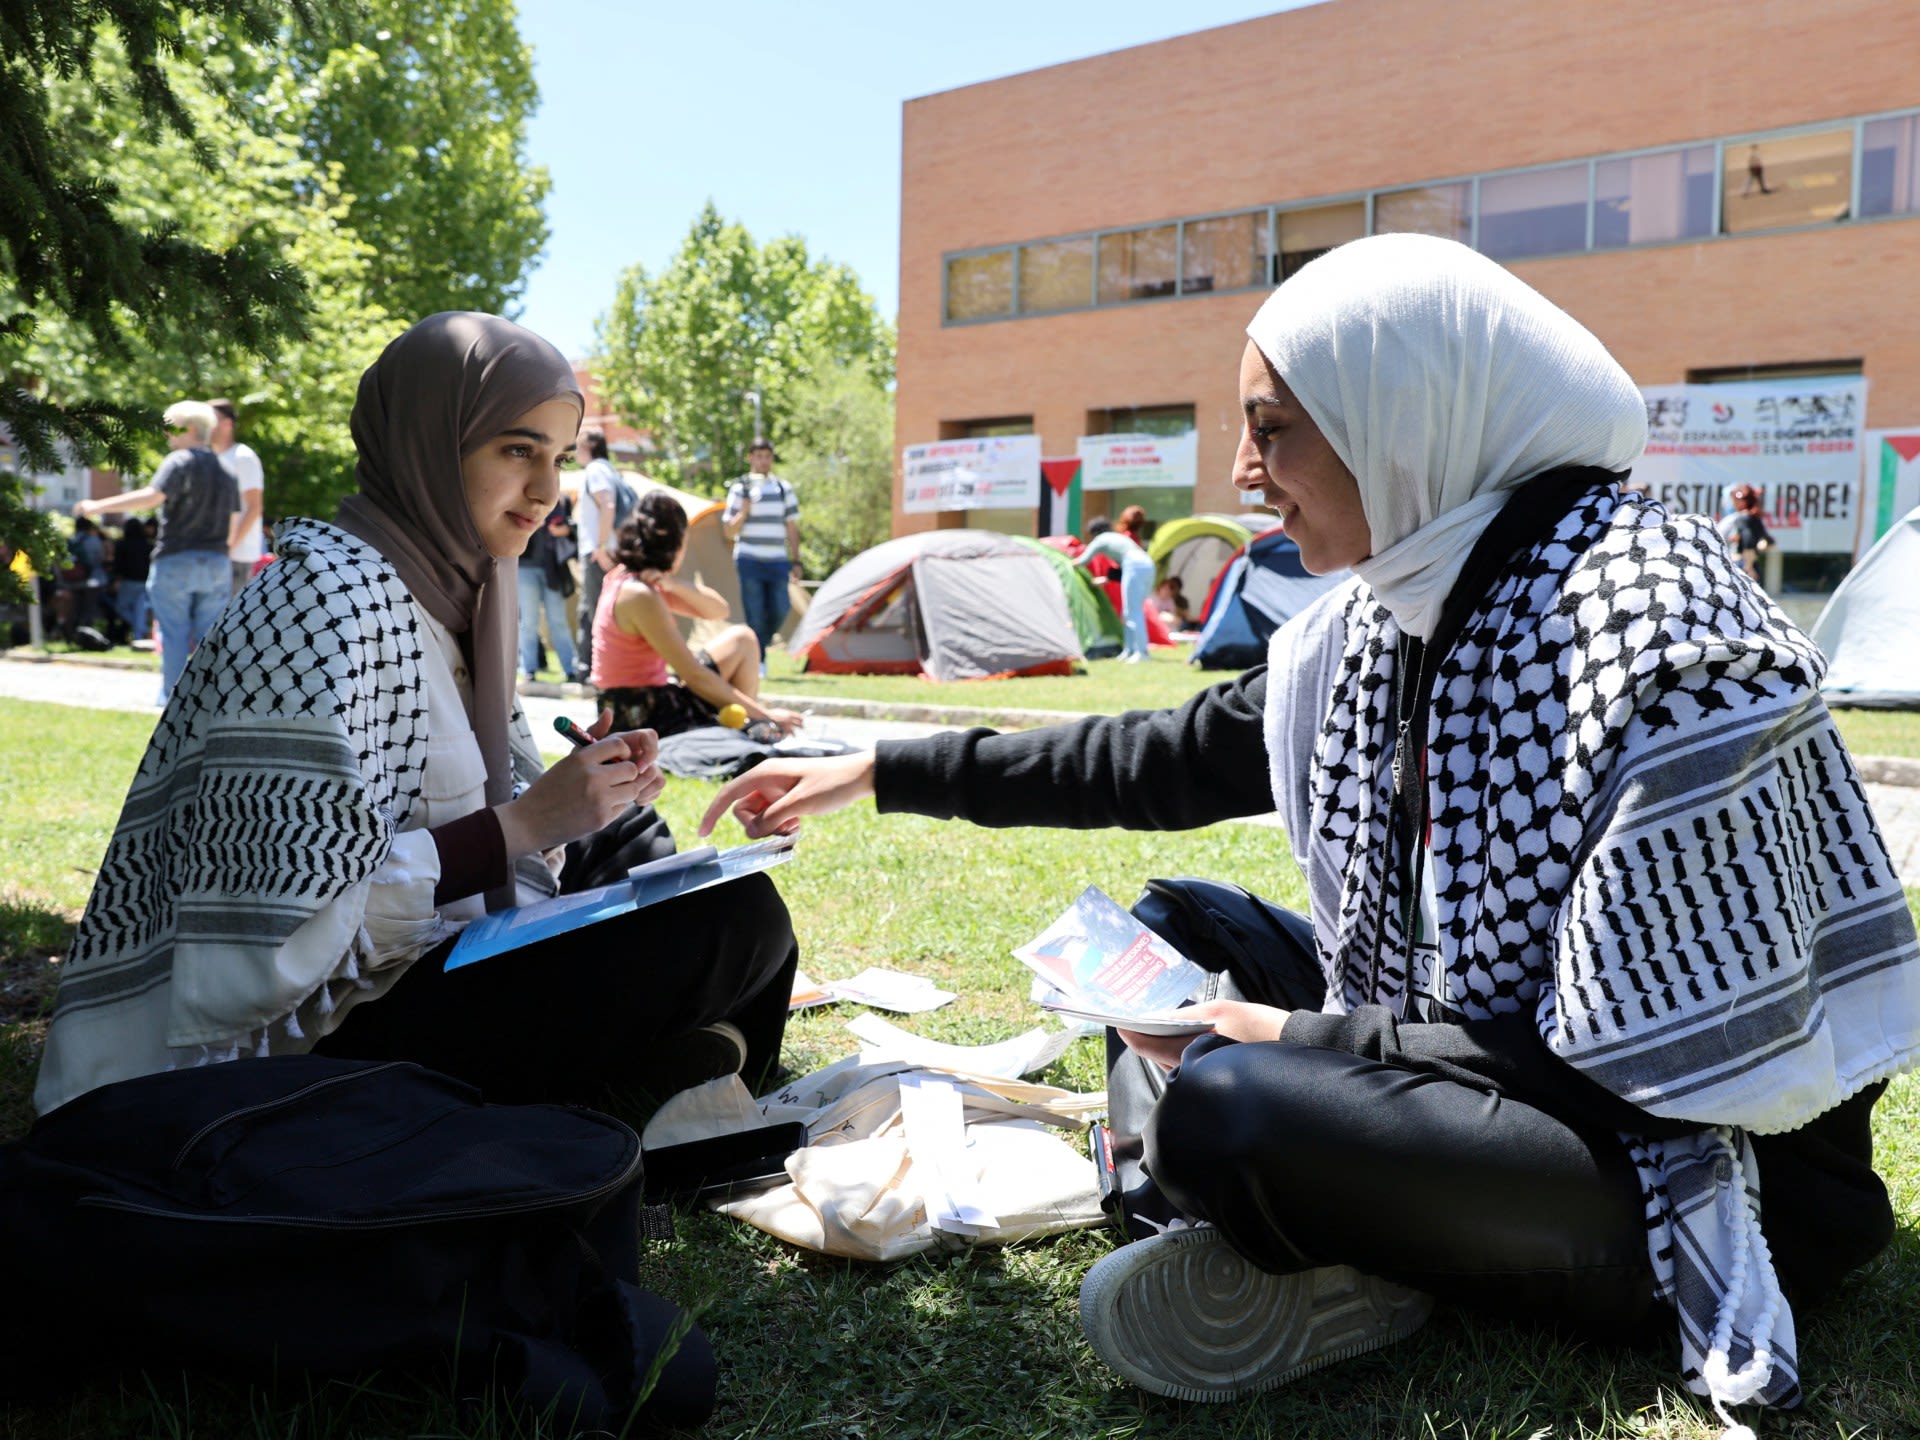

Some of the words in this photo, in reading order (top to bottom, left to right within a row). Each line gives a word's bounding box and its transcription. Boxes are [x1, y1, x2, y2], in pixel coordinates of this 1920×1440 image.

[1683, 426, 1746, 442] ESPAÑOL
[1752, 429, 1769, 441] ES
[1764, 443, 1779, 455] ES
[1784, 442, 1803, 454] UN
[1808, 440, 1855, 453] DEBER
[1760, 482, 1850, 519] LIBRE!
